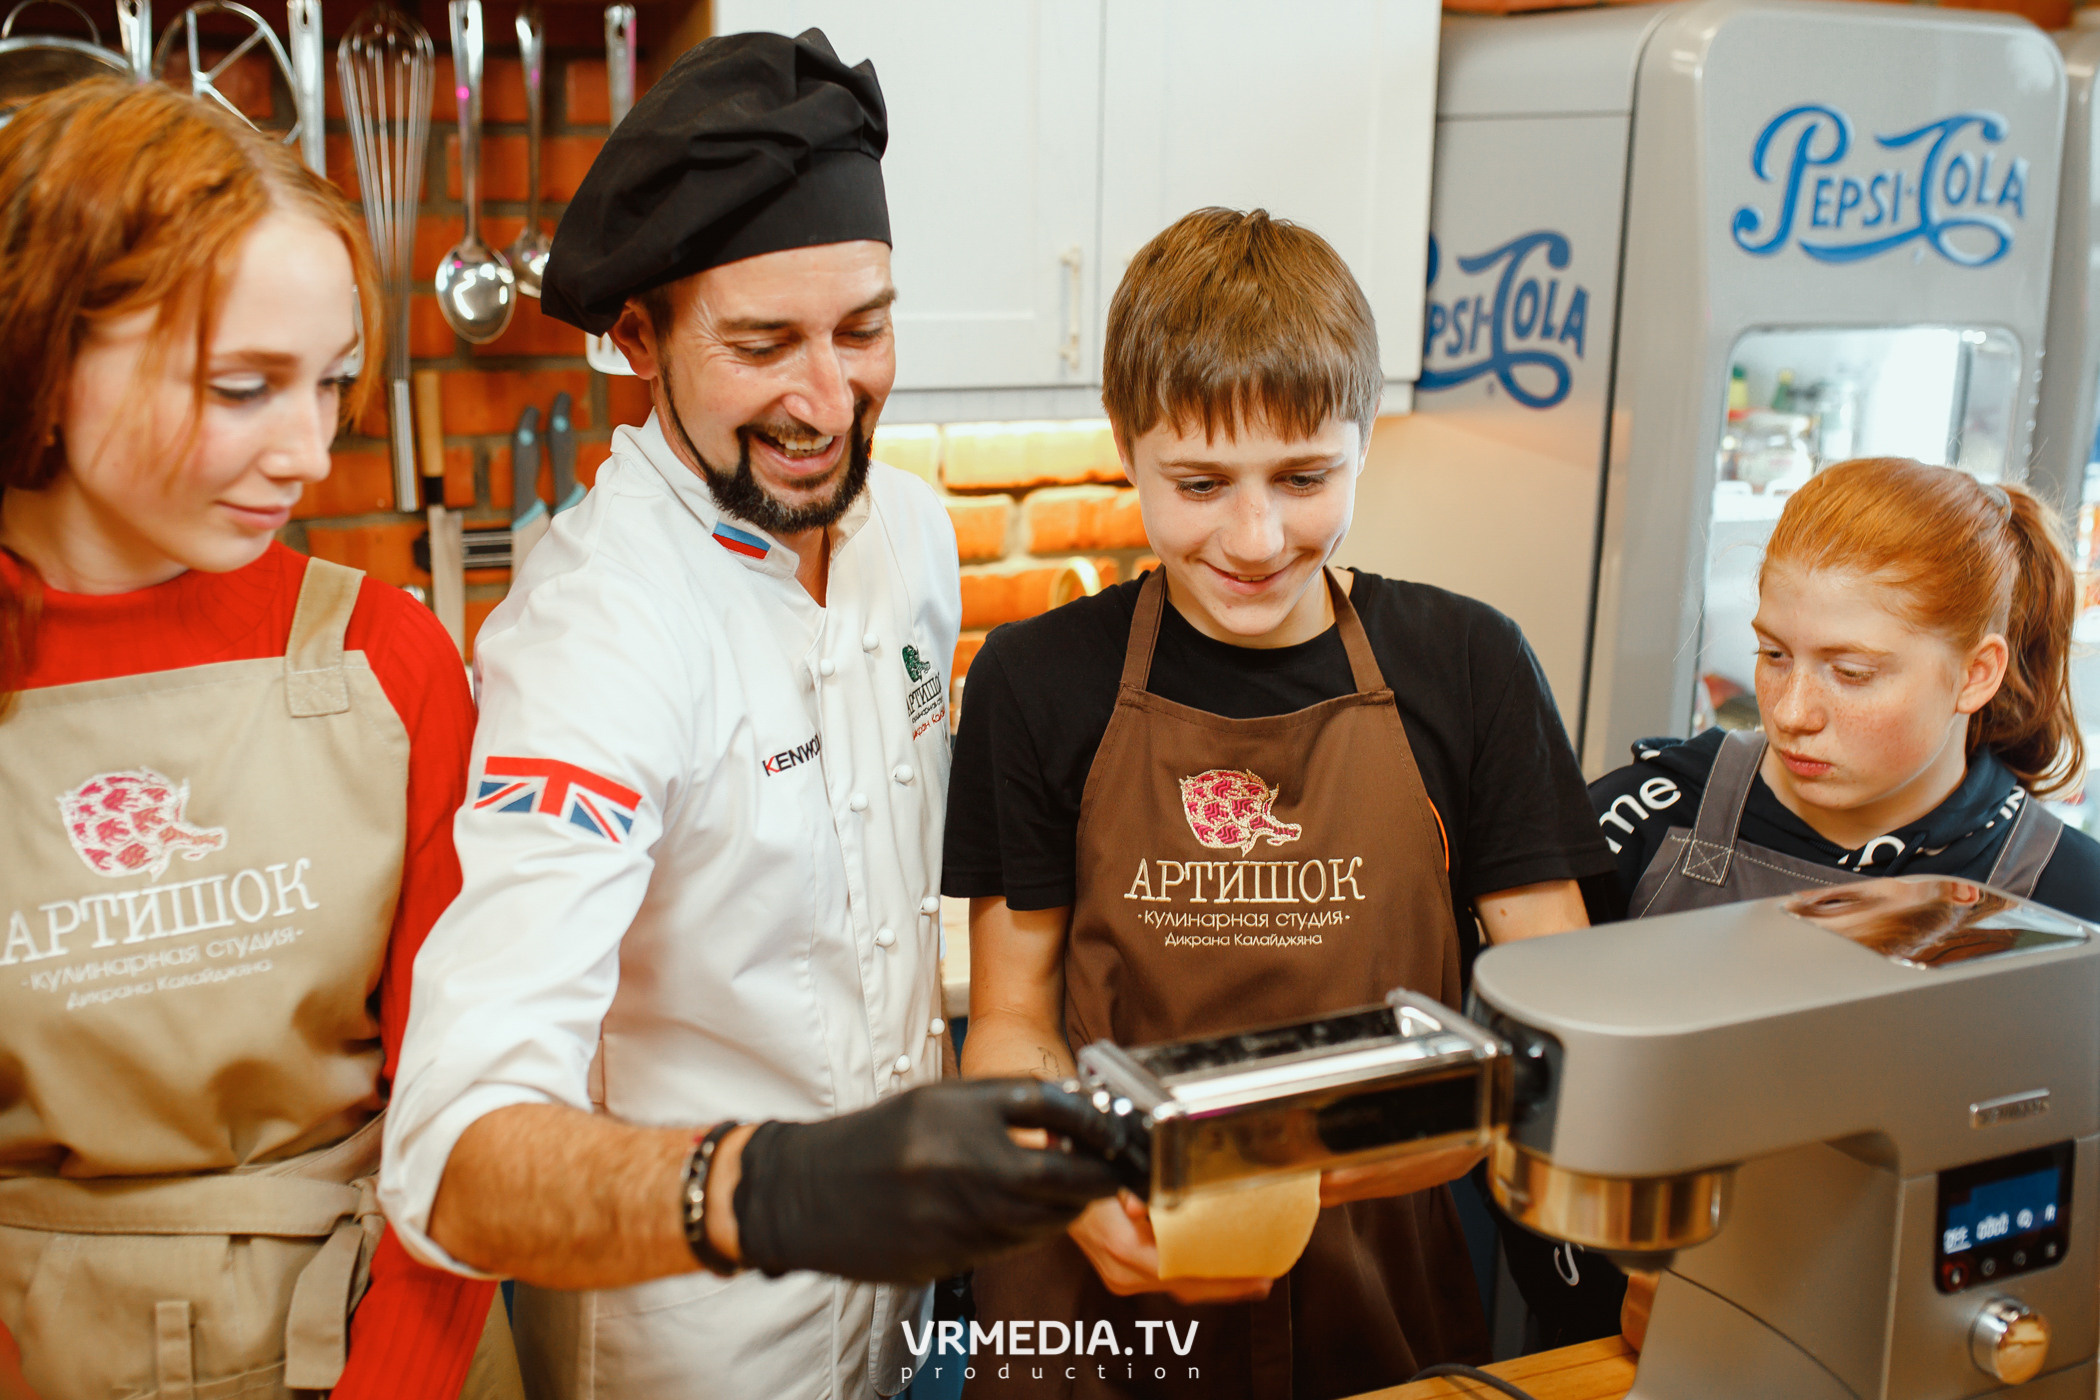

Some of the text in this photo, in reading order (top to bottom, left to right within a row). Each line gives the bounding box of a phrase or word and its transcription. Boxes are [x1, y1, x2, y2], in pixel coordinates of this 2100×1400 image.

[1124, 856, 1366, 903] АРТИШОК
[0, 858, 319, 965] АРТИШОК
[1164, 932, 1323, 948] Дикрана Калайджяна
